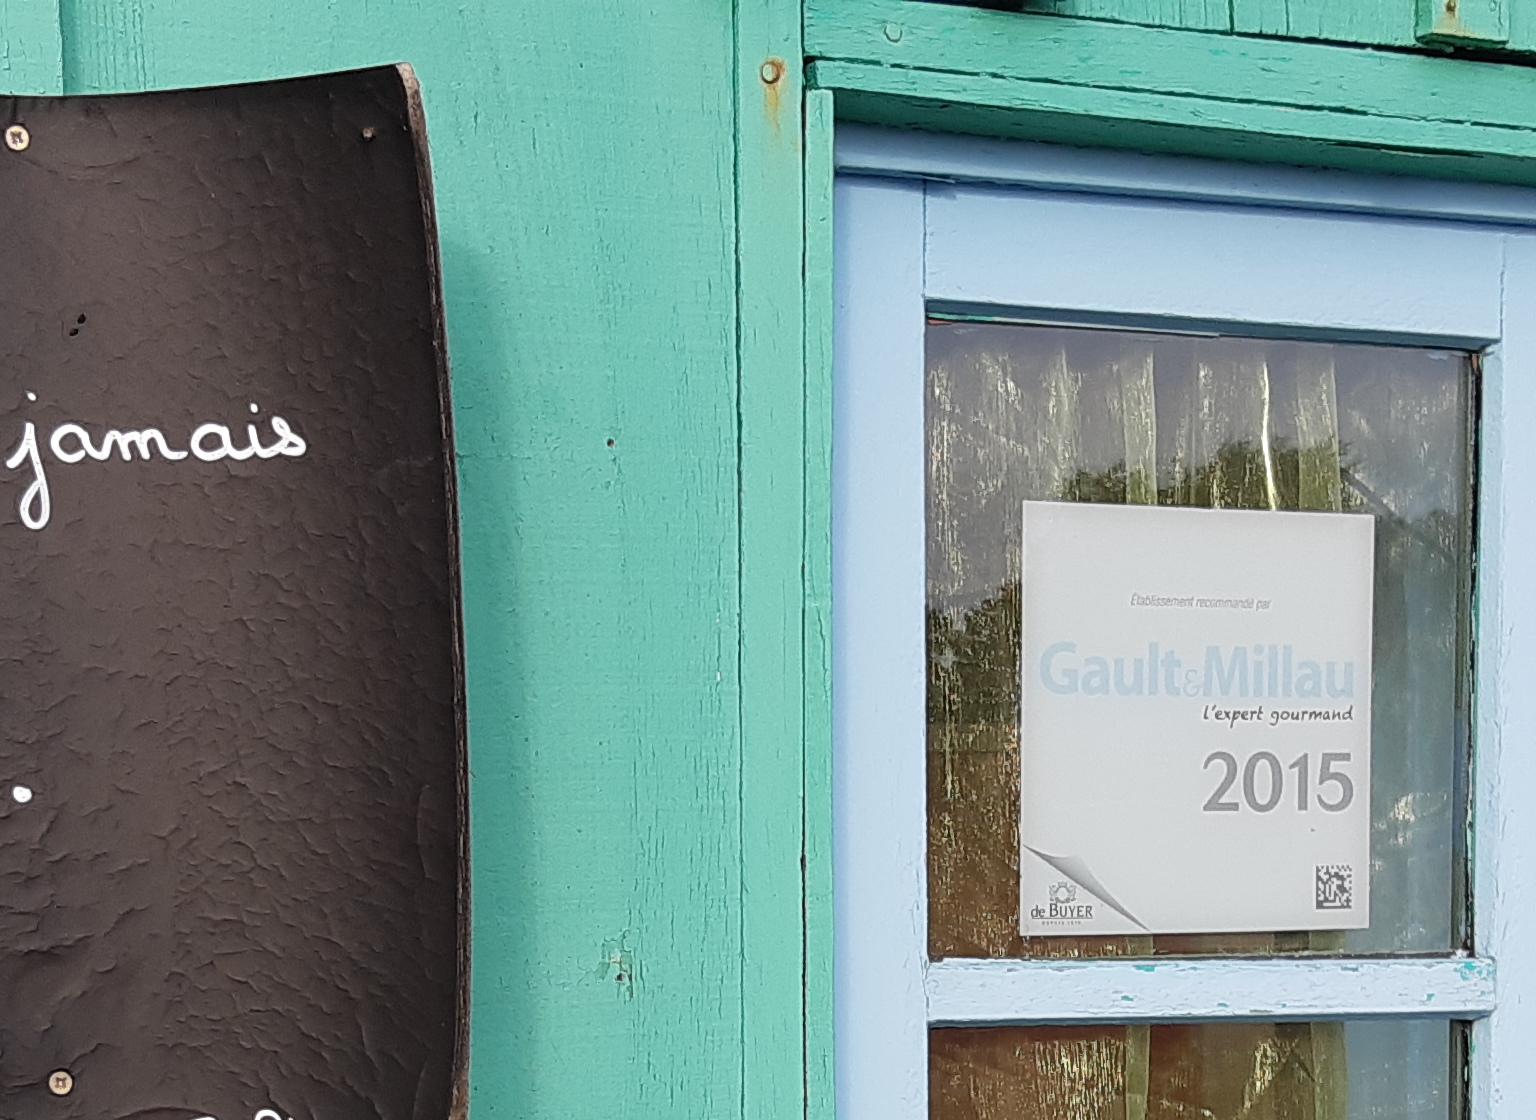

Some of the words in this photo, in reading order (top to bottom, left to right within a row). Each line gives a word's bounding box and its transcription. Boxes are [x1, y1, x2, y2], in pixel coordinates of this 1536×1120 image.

[6, 393, 307, 530] jamais
[1203, 704, 1264, 729] l'expert
[1270, 704, 1353, 727] gourmand
[1202, 751, 1354, 813] 2015
[1030, 904, 1045, 918] de
[1050, 903, 1093, 917] BUYER
